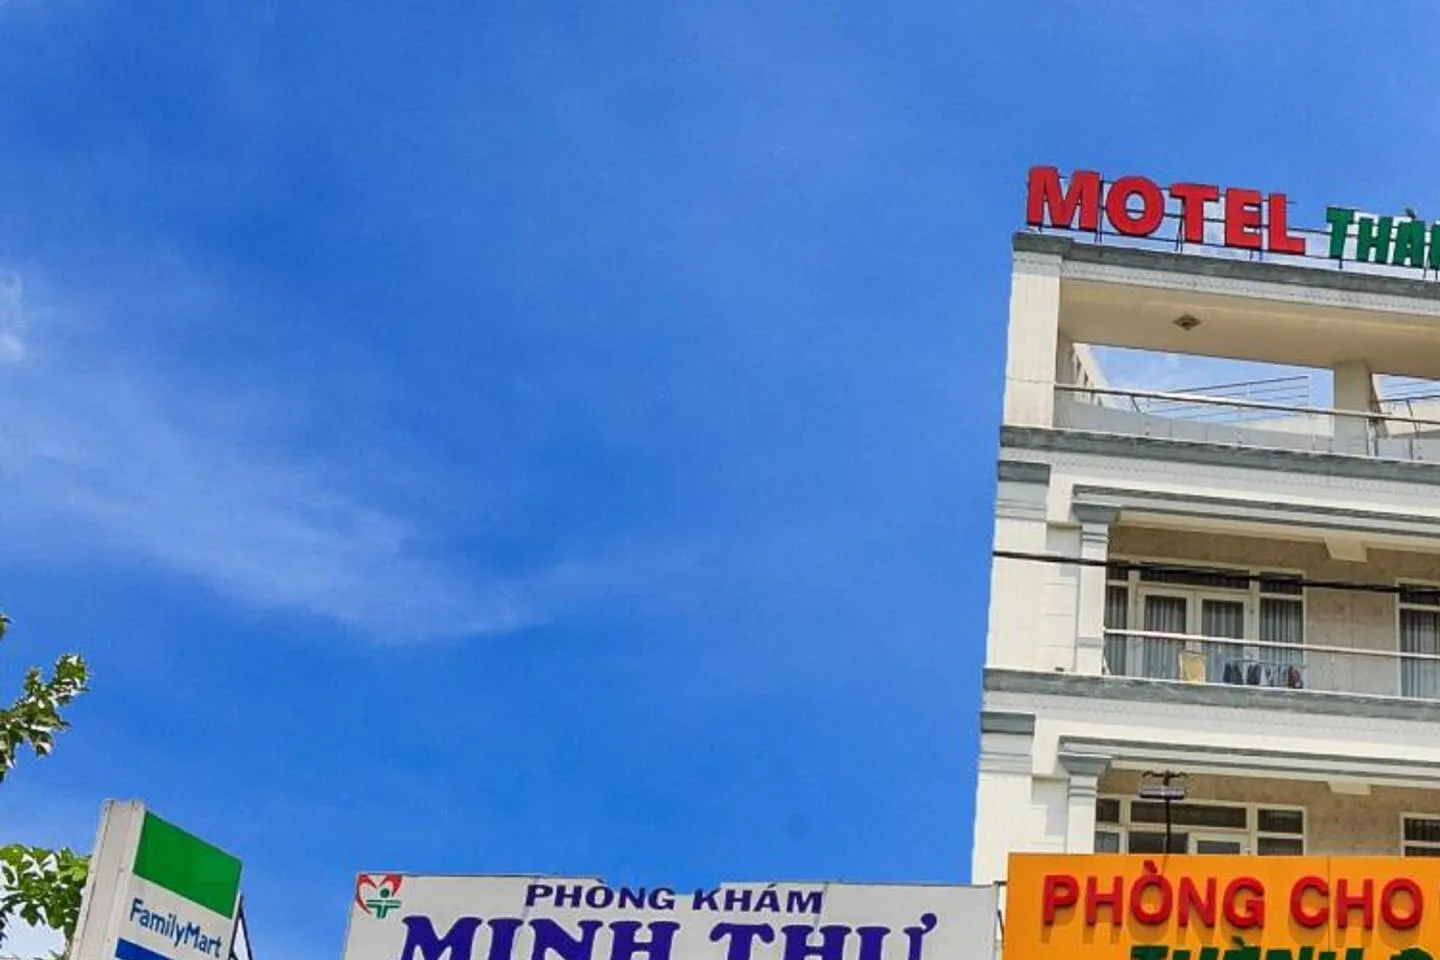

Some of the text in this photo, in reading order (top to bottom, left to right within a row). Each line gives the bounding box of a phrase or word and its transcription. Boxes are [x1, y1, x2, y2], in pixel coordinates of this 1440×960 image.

[1027, 166, 1306, 255] MOTEL
[129, 897, 224, 959] FamilyMart
[525, 879, 824, 914] PHÒNG KHÁM
[1043, 861, 1267, 931] PHÒNG
[1288, 875, 1424, 930] CHO
